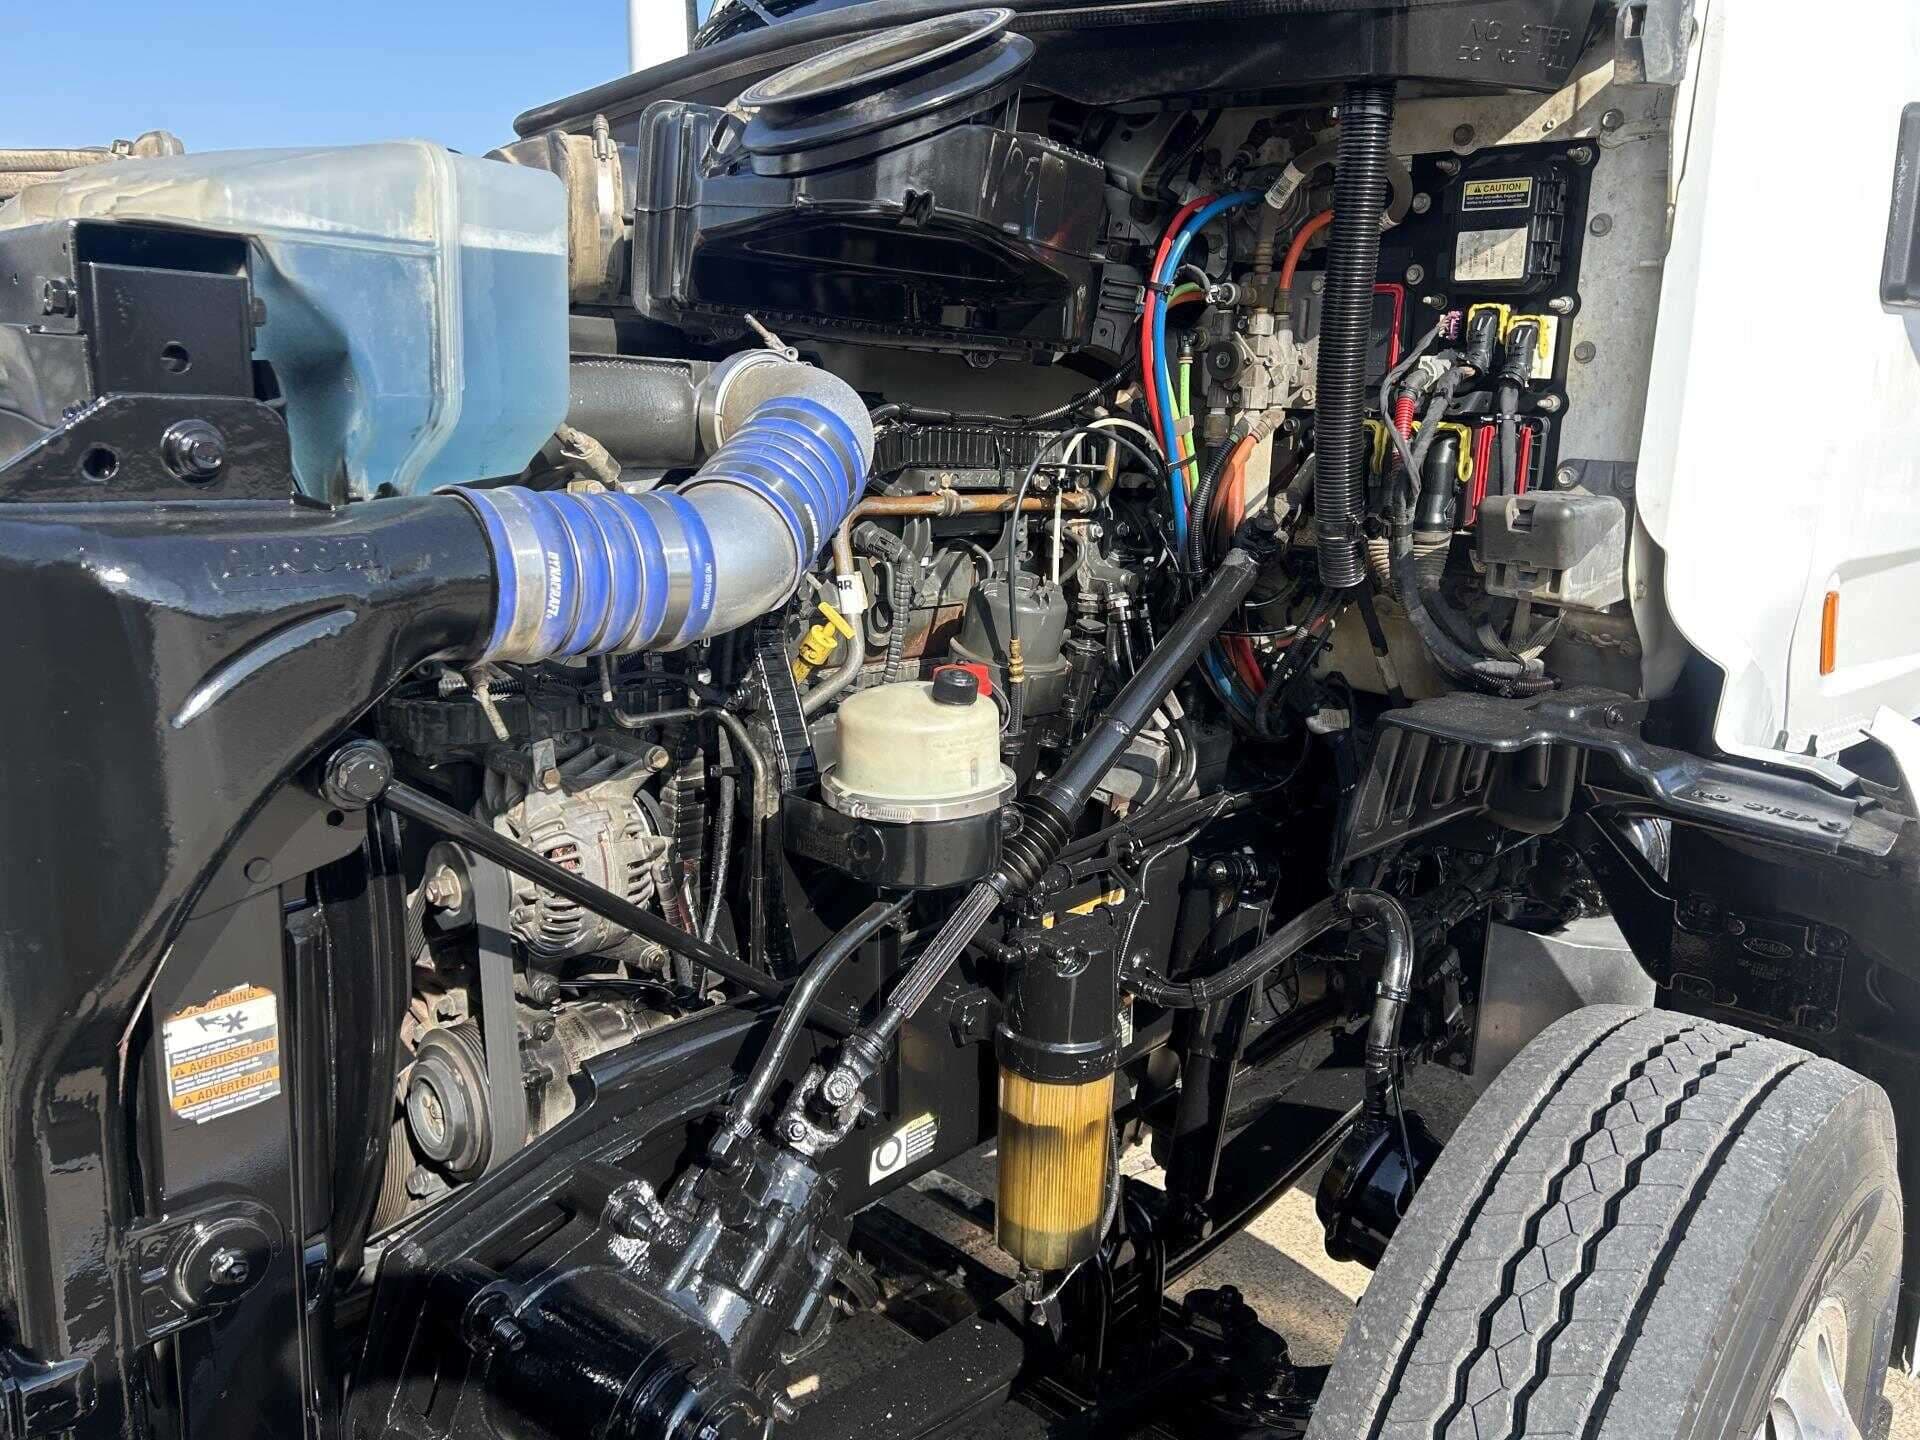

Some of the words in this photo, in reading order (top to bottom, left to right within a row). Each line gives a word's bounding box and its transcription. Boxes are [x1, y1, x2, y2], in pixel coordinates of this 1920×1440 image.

[1463, 18, 1502, 41] NO
[1520, 23, 1571, 47] STEP
[1483, 183, 1522, 194] CAUTION
[1691, 789, 1732, 803] NO
[1743, 801, 1819, 822] STEP
[189, 1039, 275, 1072] AVERTISSEMENT
[197, 1070, 273, 1100] ADVERTENCIA
